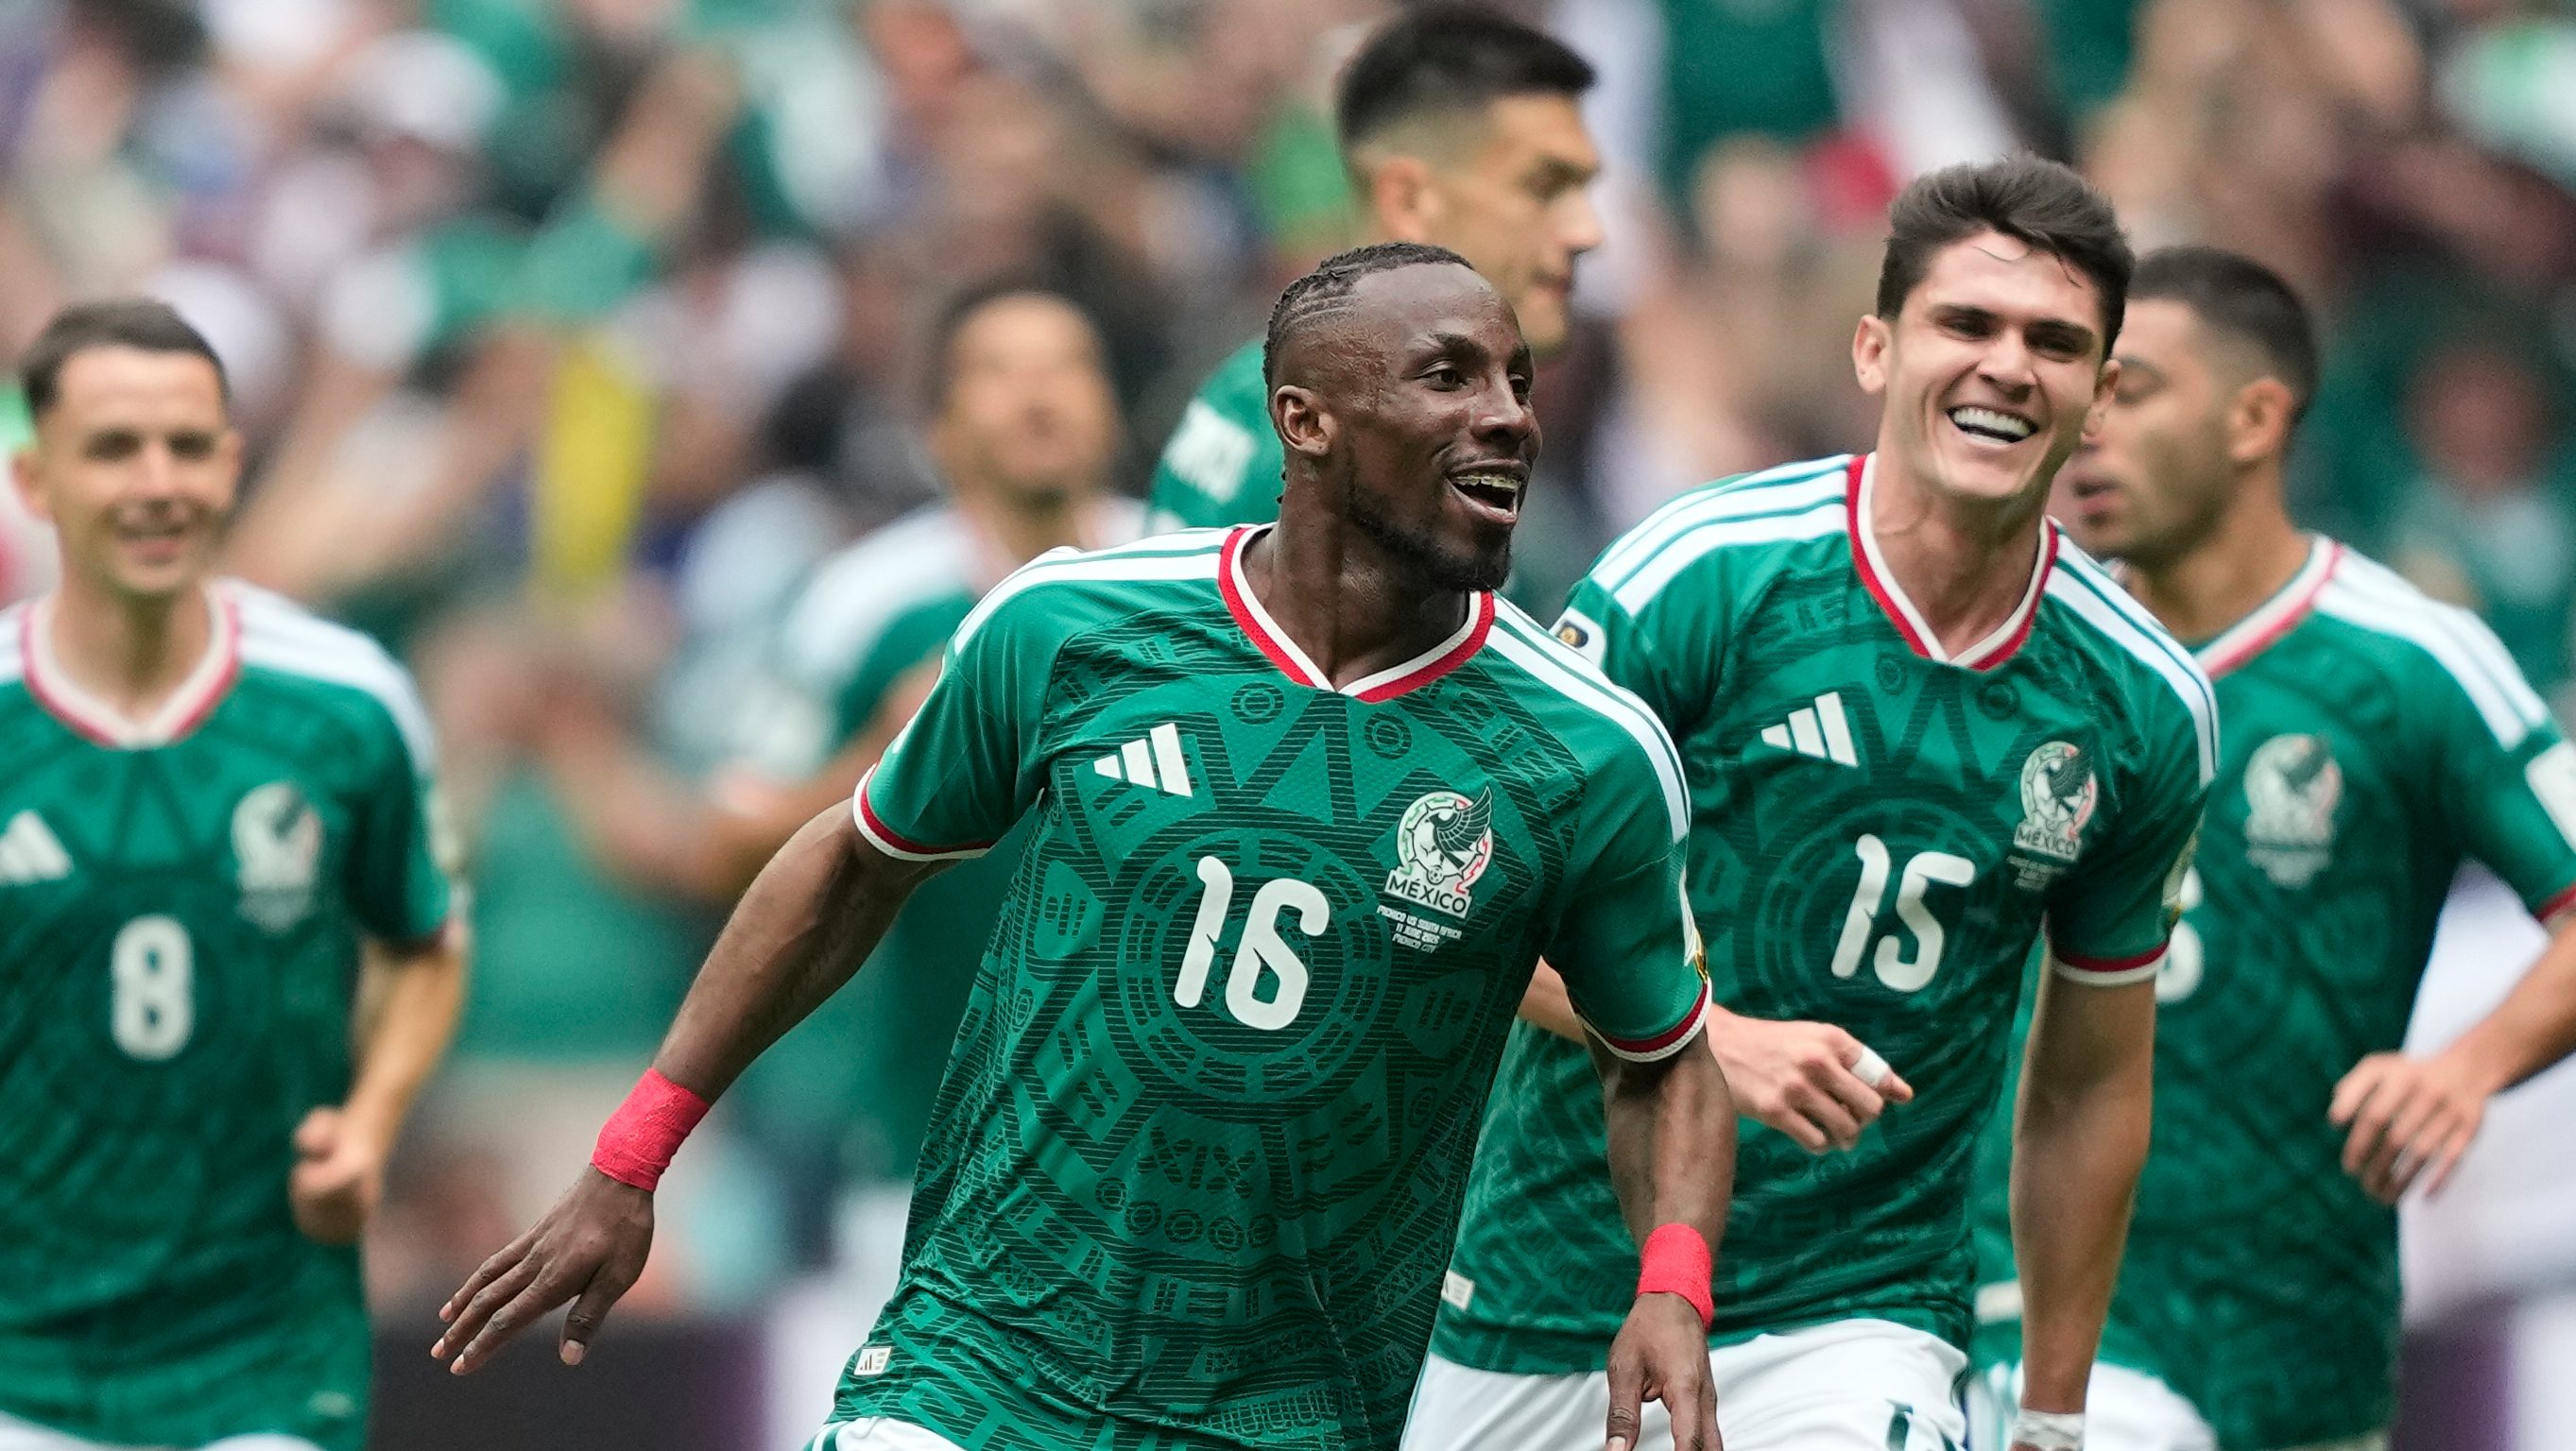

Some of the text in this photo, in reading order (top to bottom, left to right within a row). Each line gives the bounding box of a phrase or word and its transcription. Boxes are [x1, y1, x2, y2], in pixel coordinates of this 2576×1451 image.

[1174, 855, 1331, 1031] 16
[1388, 875, 1468, 913] MÉXICO
[1830, 833, 1976, 992] 15
[111, 913, 195, 1061] 8
